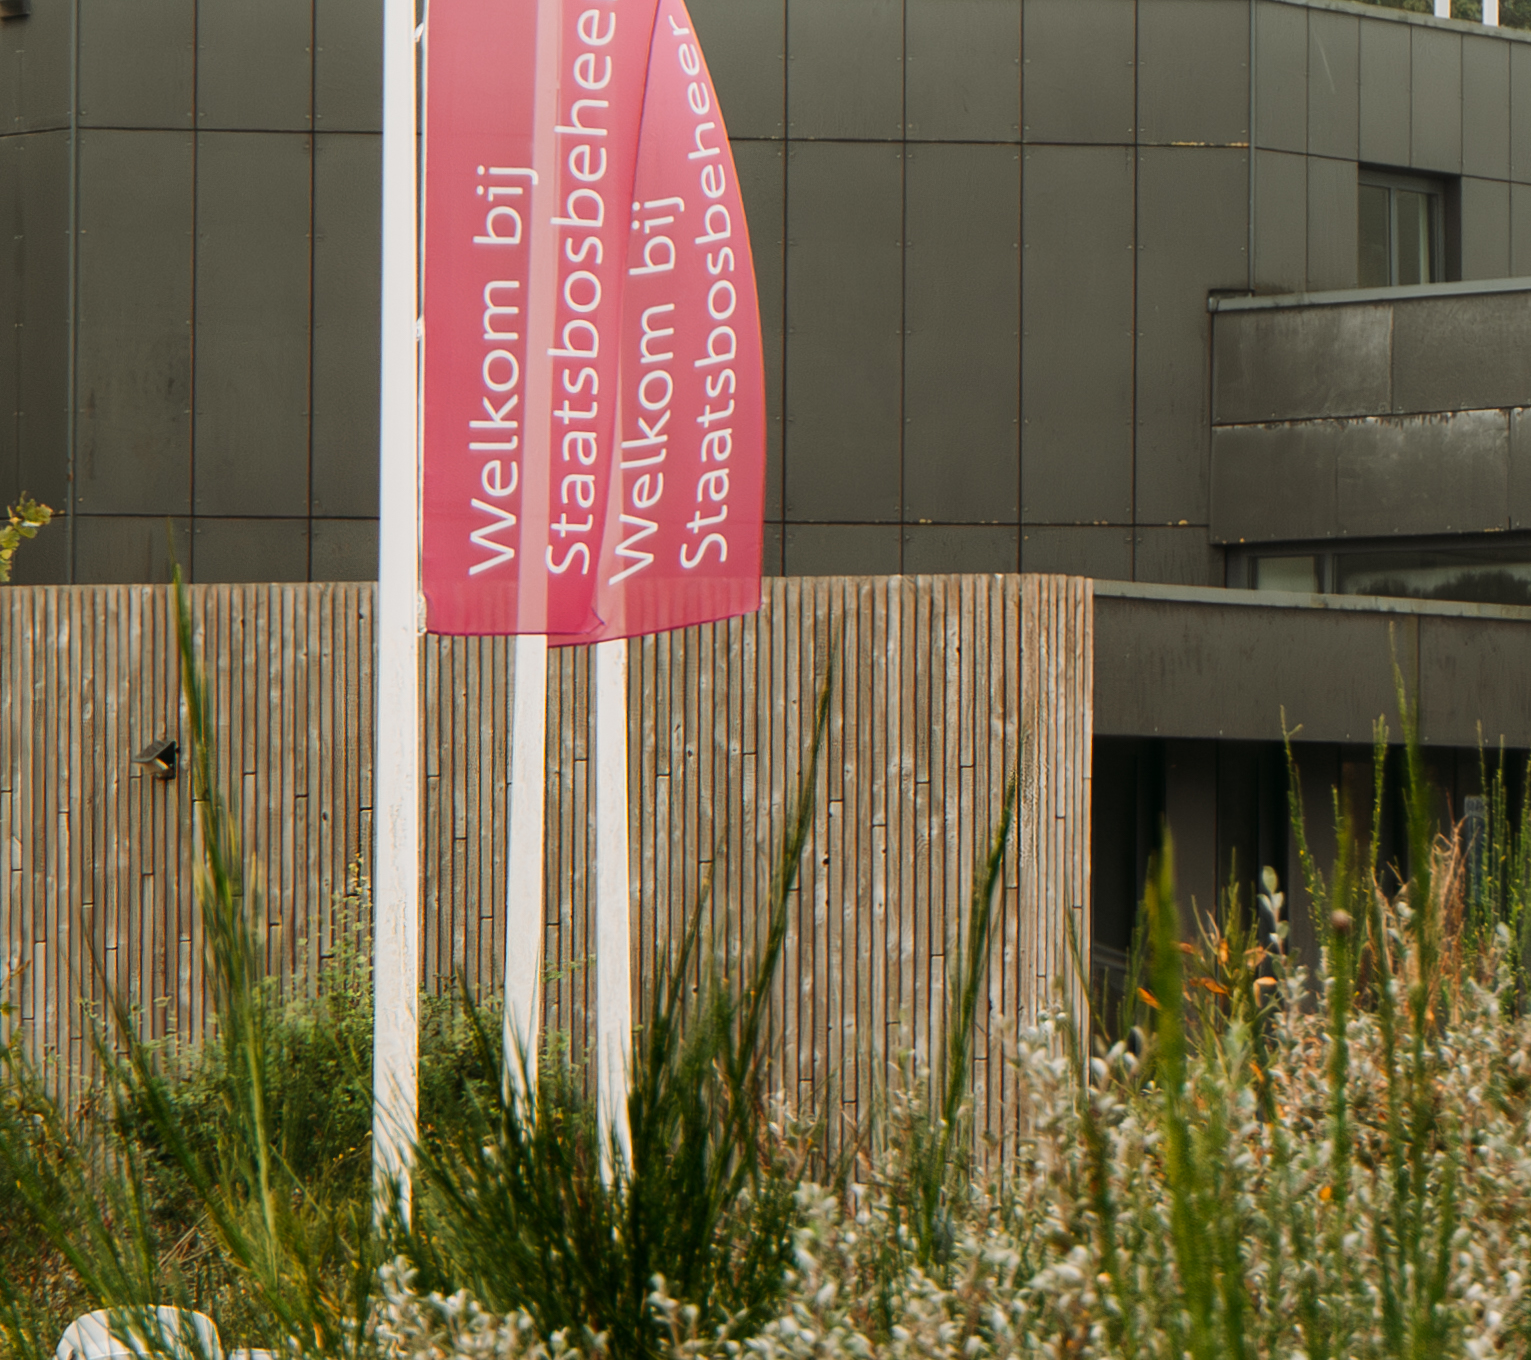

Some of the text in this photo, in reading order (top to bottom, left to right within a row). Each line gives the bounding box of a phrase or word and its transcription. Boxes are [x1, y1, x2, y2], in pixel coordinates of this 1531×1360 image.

[469, 165, 539, 575] Welkom bij
[609, 197, 685, 585] Welkom bij
[669, 15, 738, 569] Staatsbosbeheer
